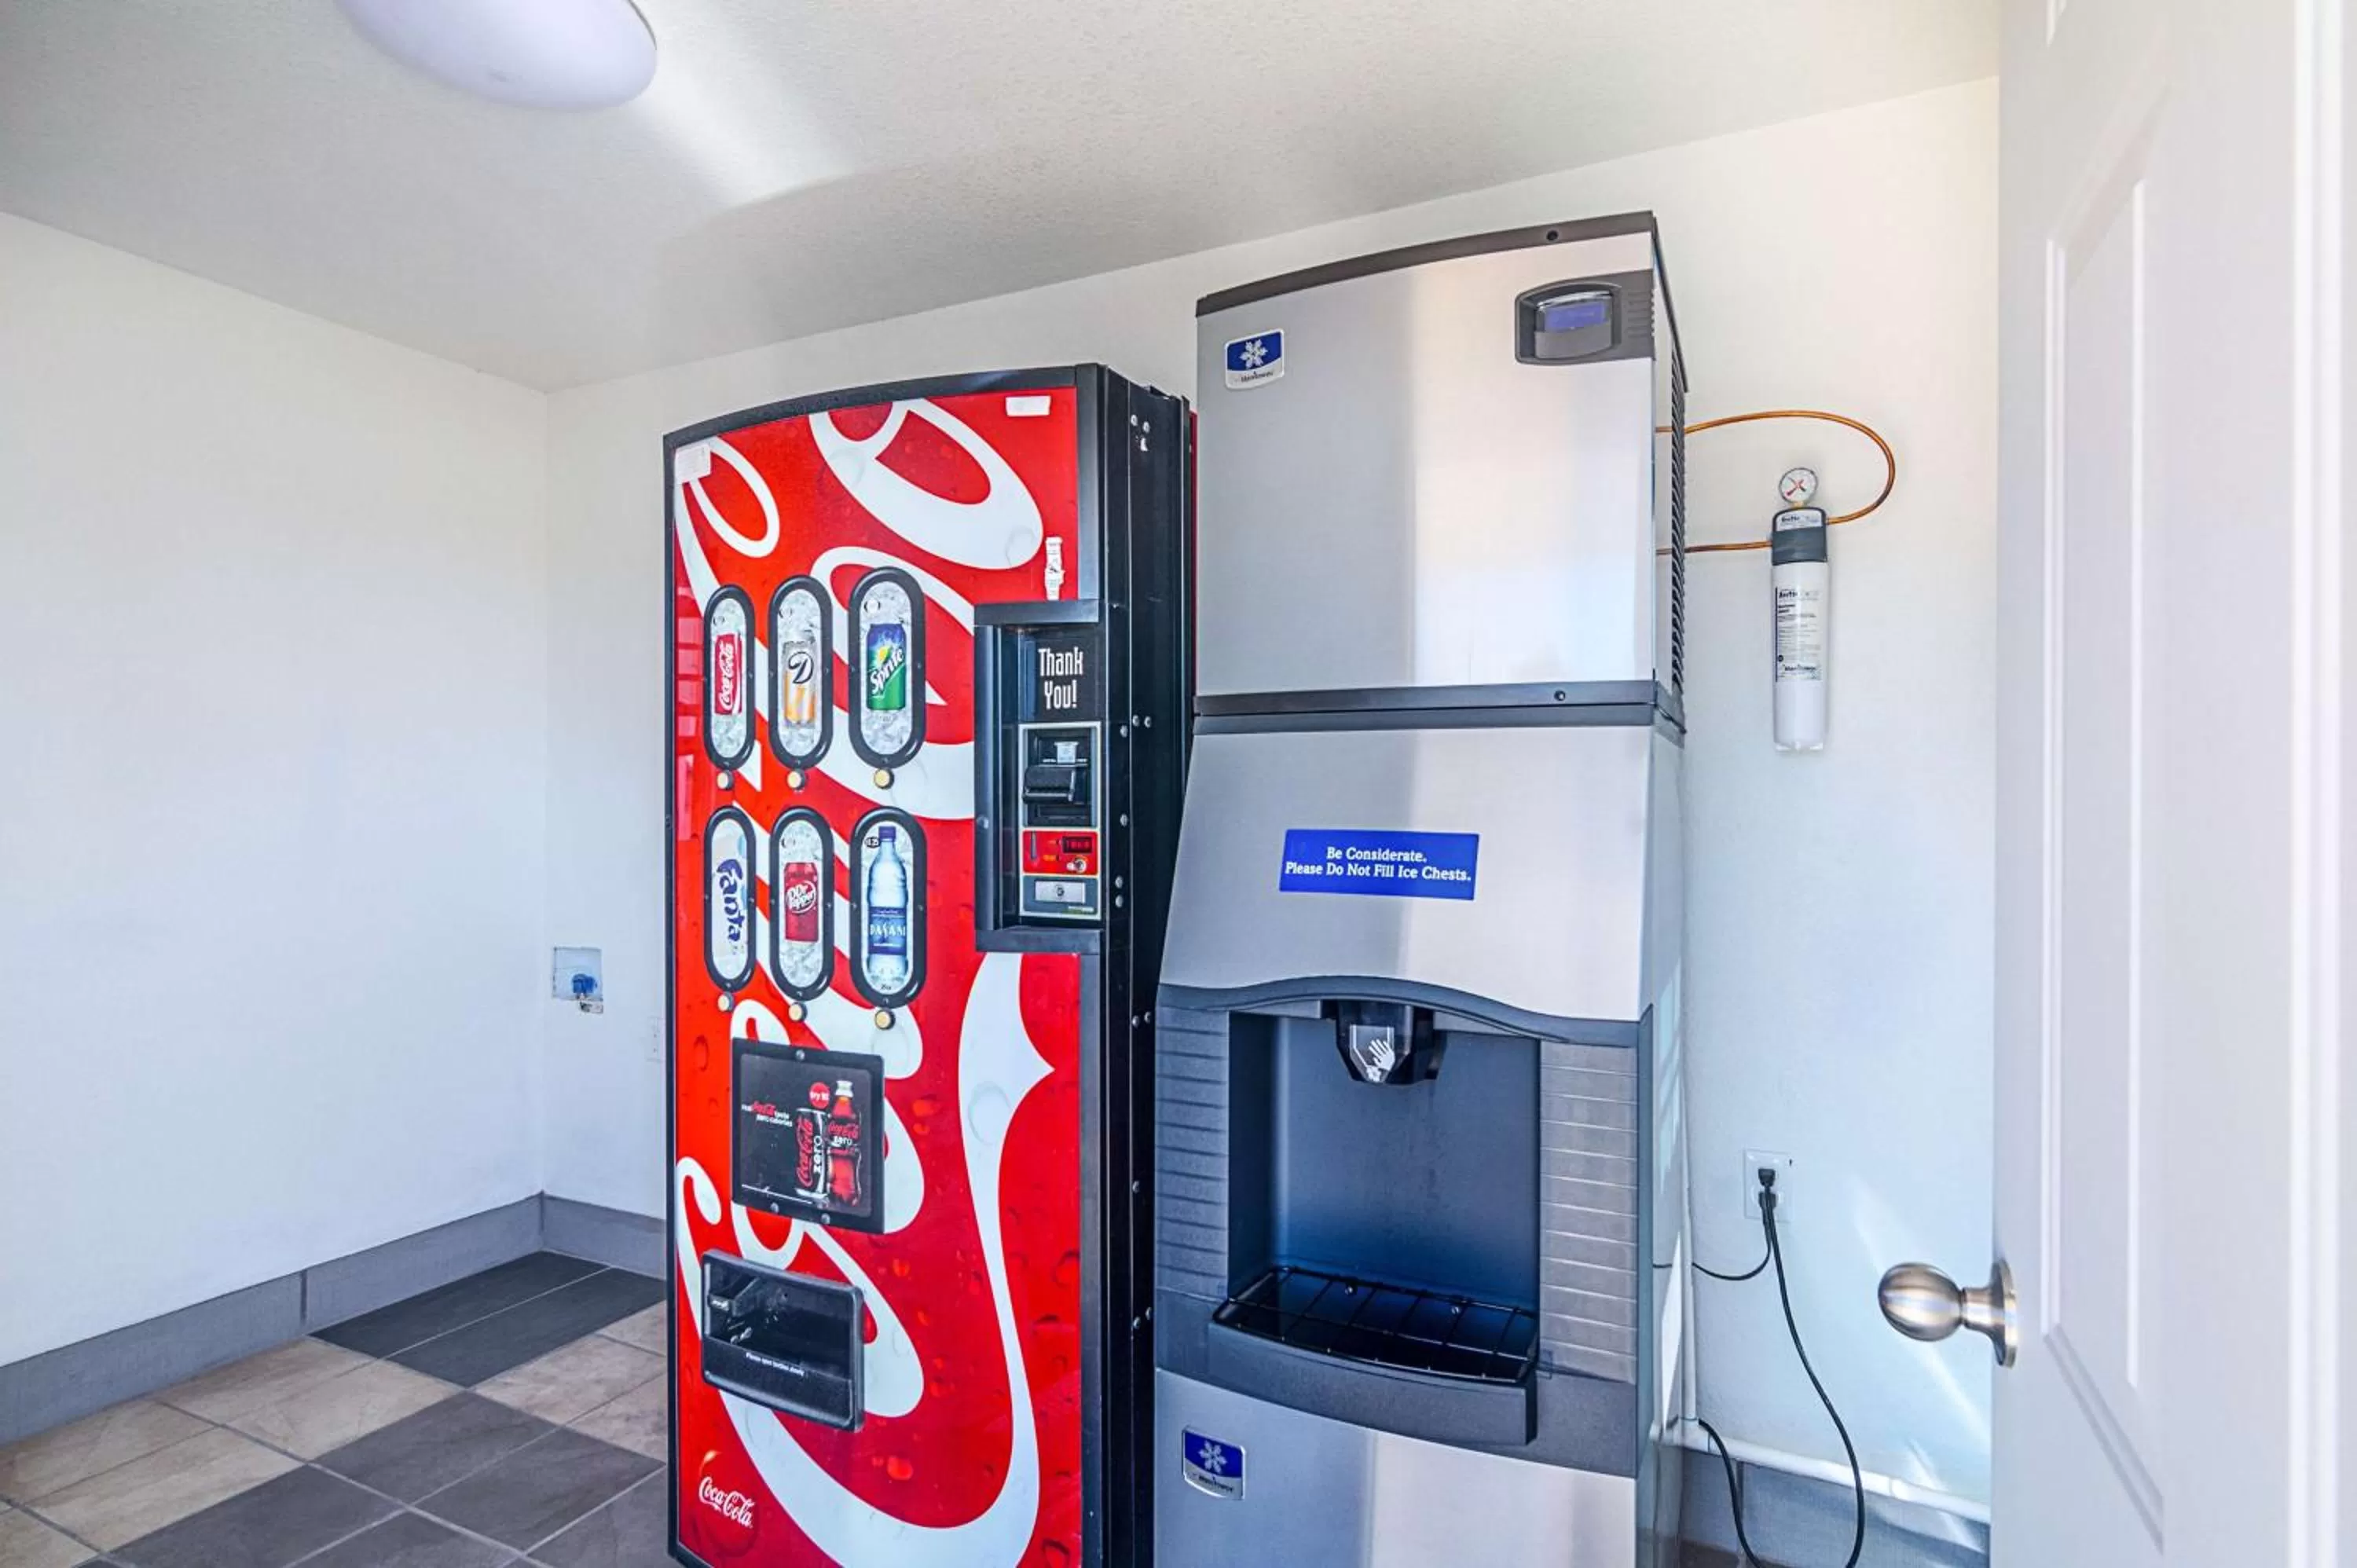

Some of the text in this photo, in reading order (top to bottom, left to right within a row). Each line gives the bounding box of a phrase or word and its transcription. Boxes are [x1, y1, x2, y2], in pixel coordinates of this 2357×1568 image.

[870, 646, 904, 694] Sprite
[1038, 646, 1084, 676] Thank
[1043, 679, 1078, 710] You!
[1326, 846, 1428, 863] Be Considerate.
[1285, 861, 1472, 881] Please Do Not Fill Ice Chests.
[716, 859, 746, 942] Fanta
